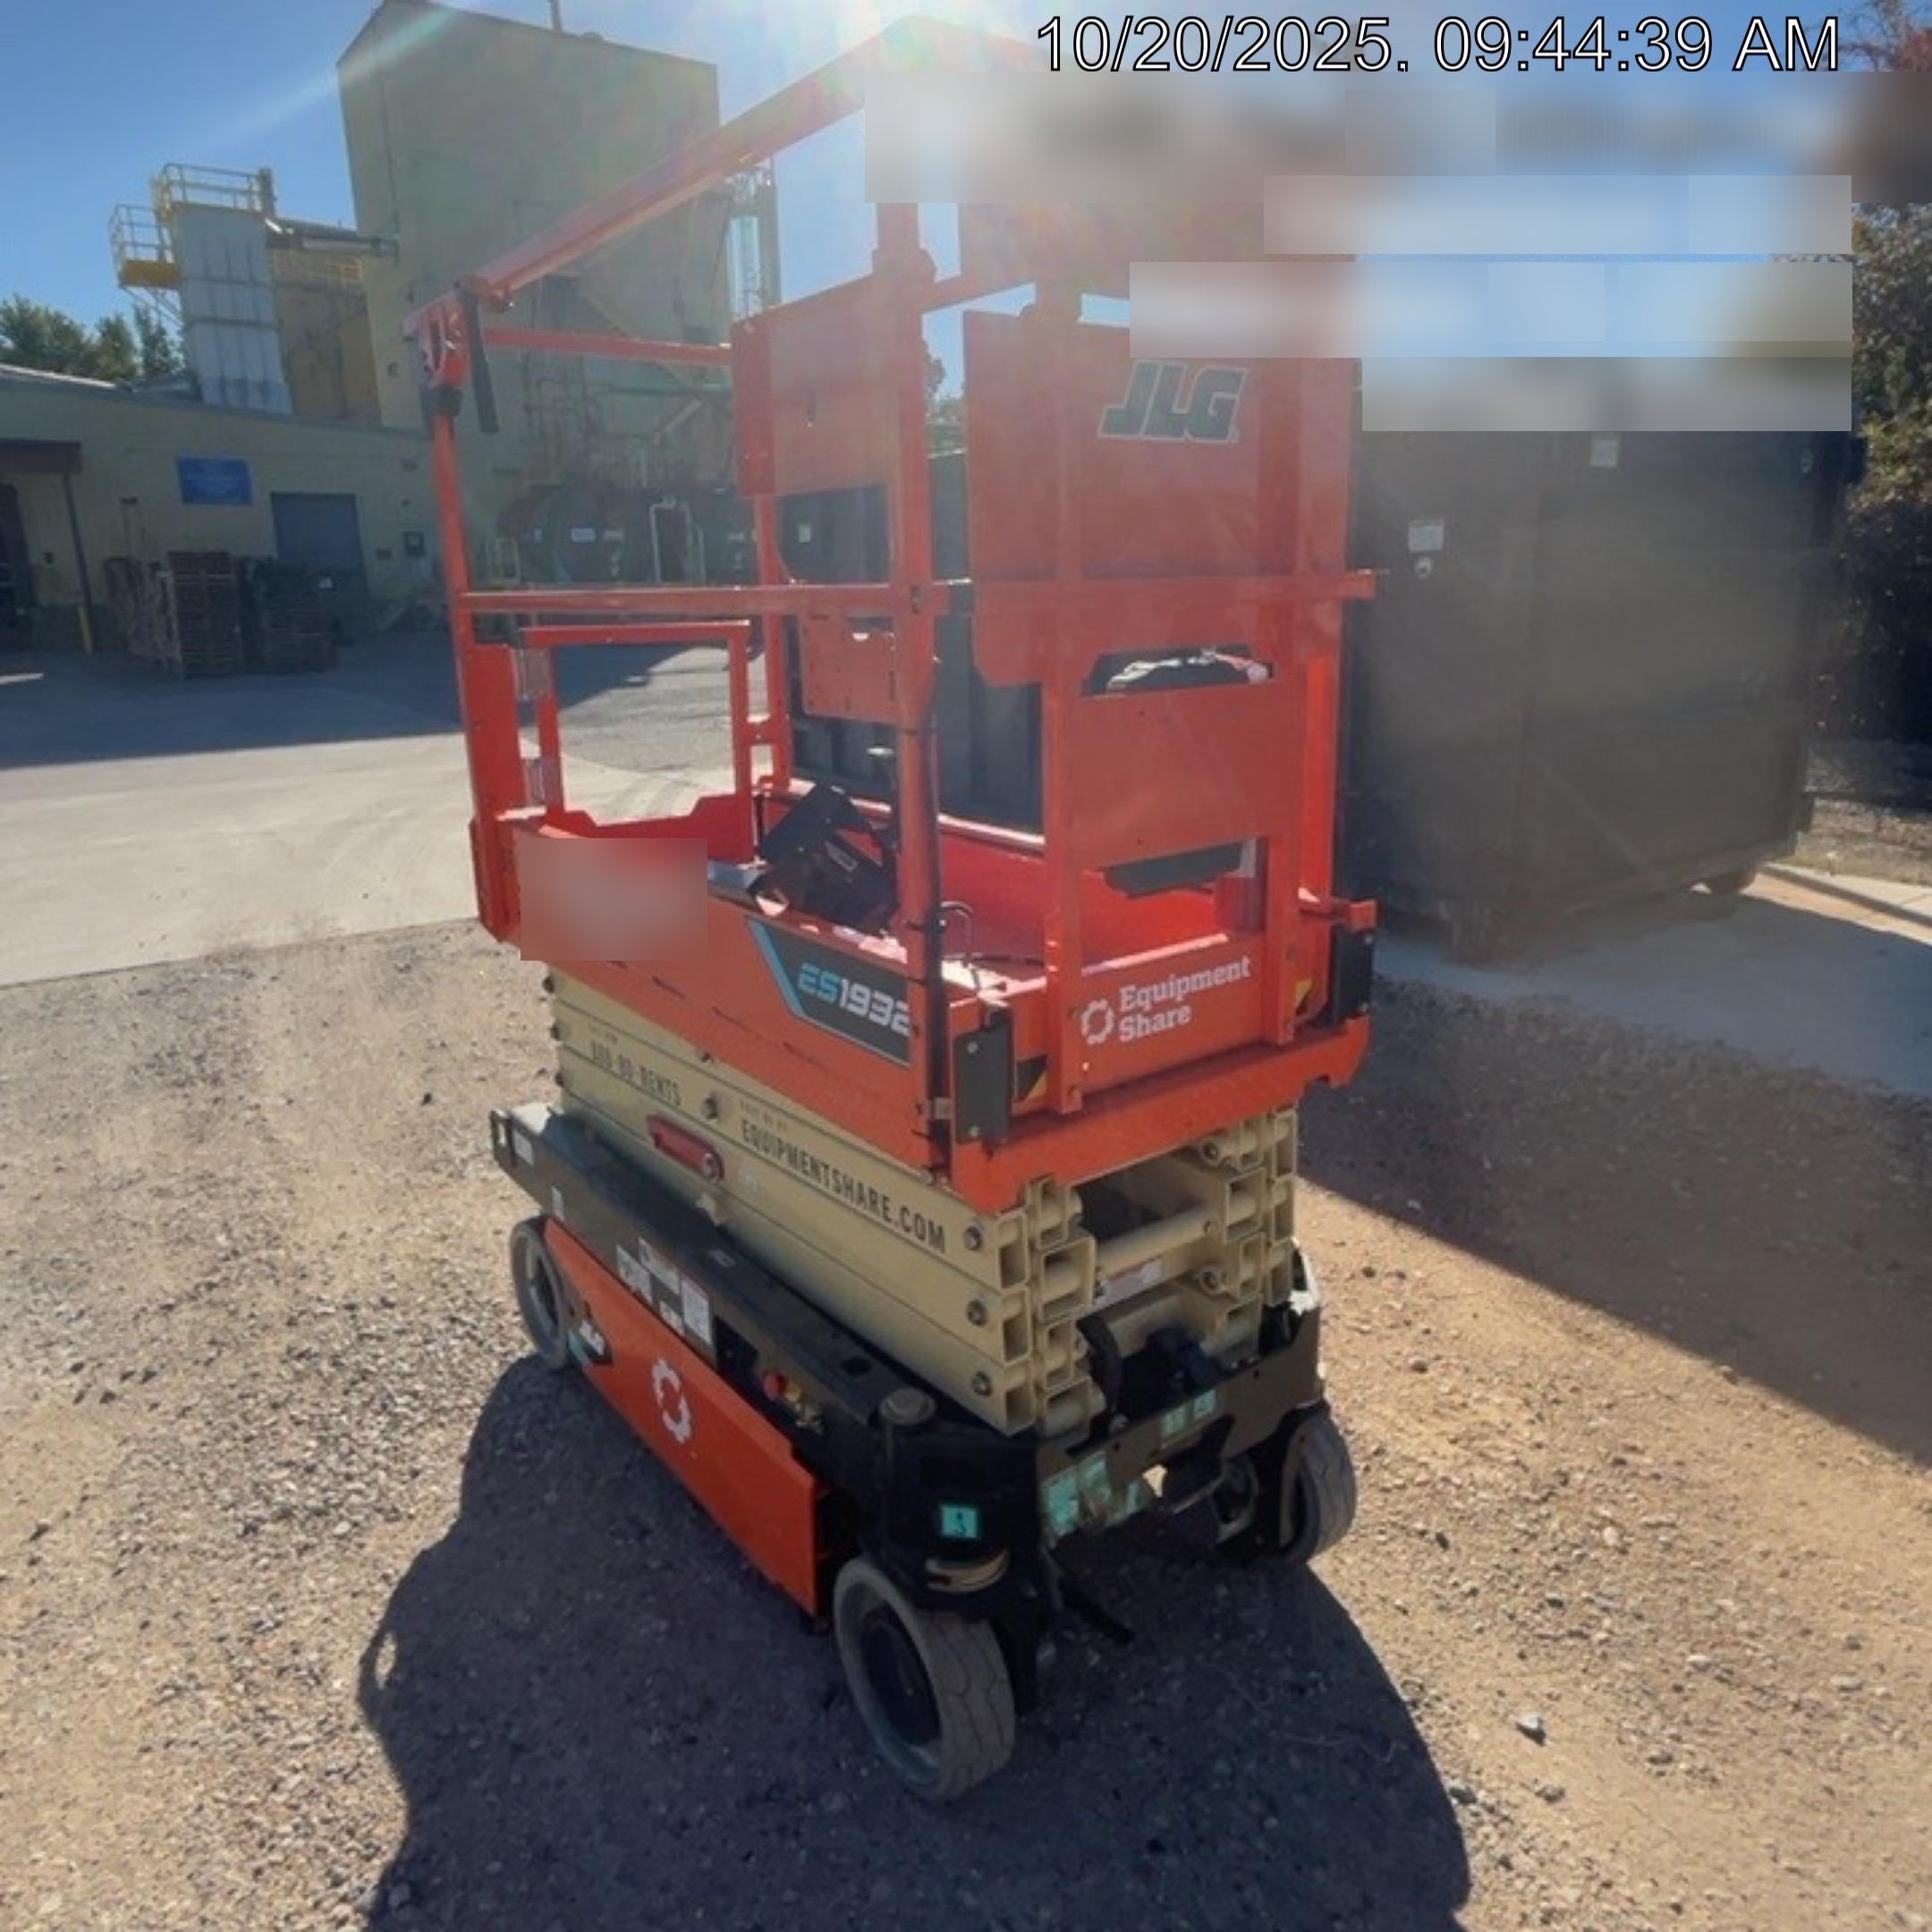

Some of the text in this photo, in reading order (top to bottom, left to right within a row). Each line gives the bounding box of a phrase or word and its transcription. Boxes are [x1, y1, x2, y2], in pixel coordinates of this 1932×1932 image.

[1097, 360, 1248, 444] JLG
[799, 962, 909, 1038] ES1932
[1120, 956, 1251, 1012] Equipment
[1120, 1004, 1191, 1042] Share
[741, 1118, 945, 1253] EQUIPMENTSHARE.COM
